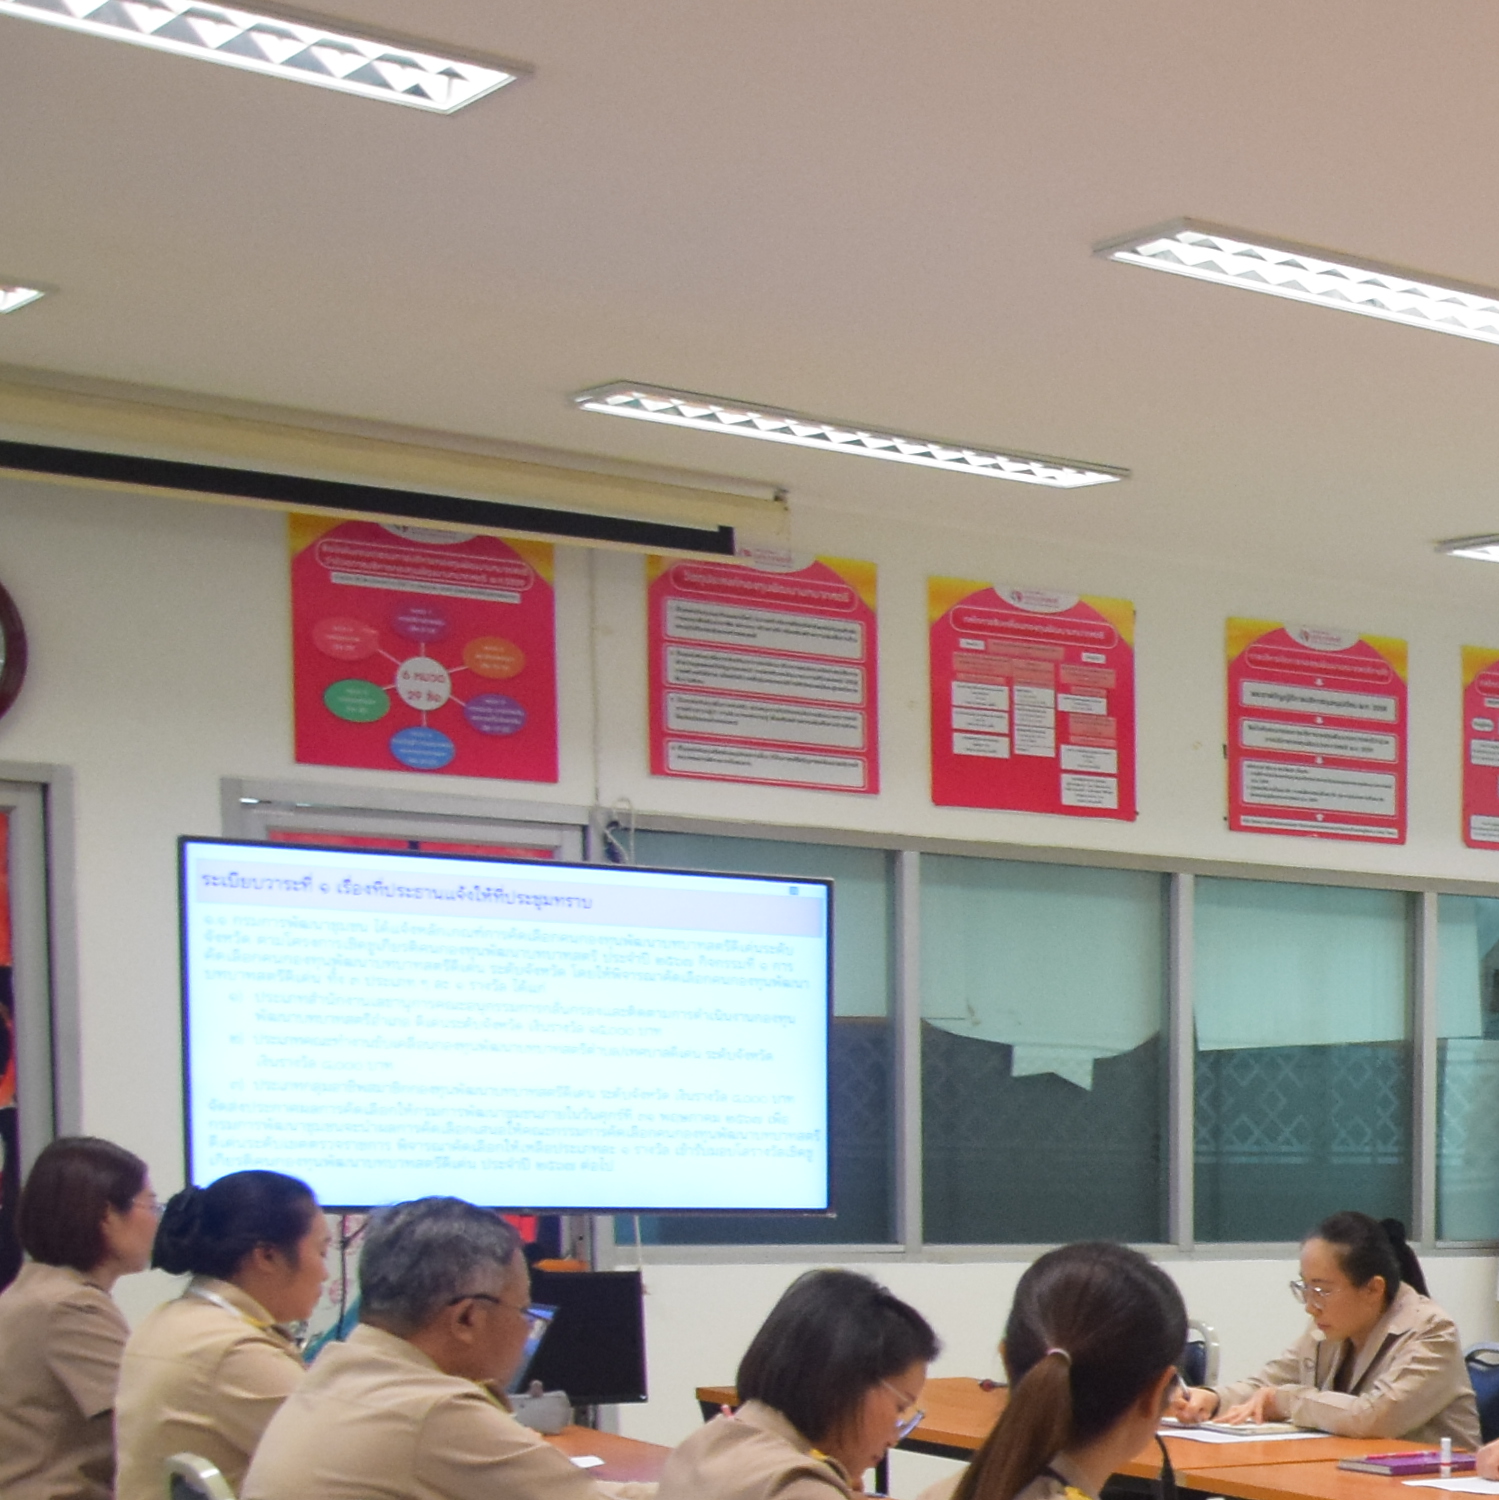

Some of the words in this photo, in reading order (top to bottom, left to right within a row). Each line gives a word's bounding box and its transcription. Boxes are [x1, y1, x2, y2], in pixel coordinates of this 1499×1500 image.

[201, 870, 312, 891] ระเบียบวาระที่
[319, 882, 328, 893] ๑
